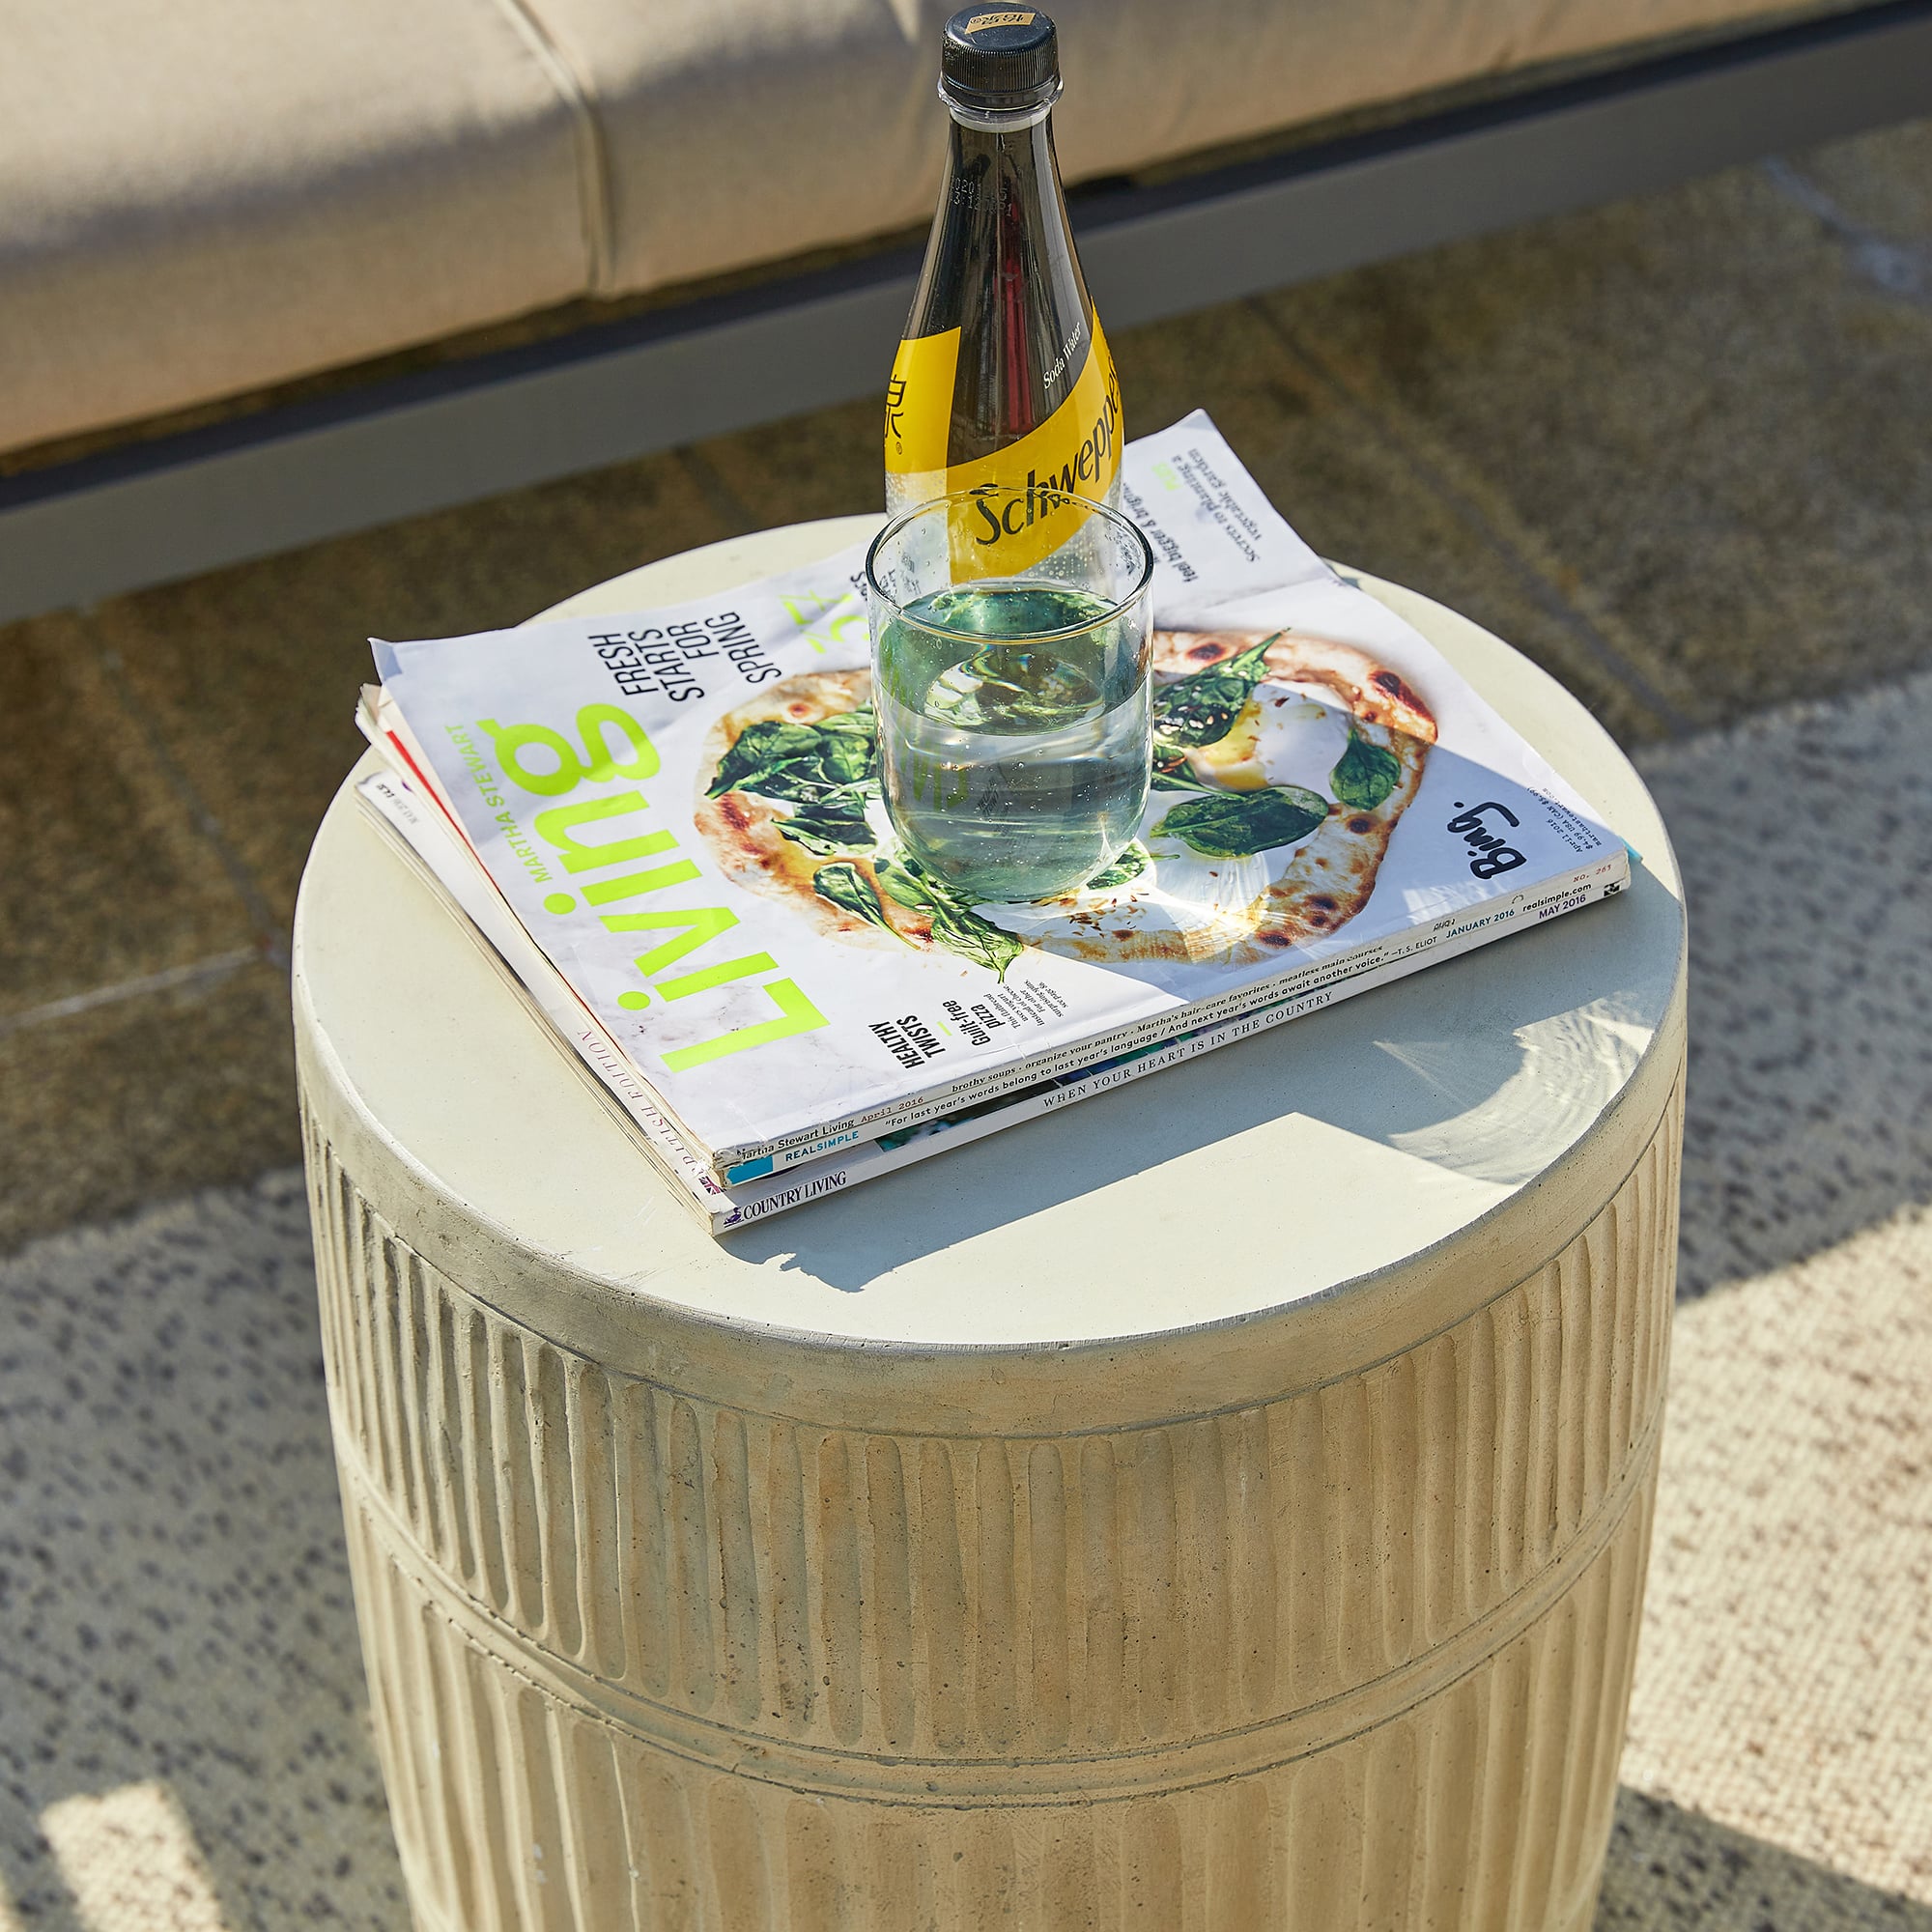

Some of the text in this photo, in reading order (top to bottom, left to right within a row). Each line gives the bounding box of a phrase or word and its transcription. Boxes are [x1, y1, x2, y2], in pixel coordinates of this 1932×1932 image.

[1043, 322, 1080, 389] Soda Water
[1178, 463, 1221, 512] planting
[1188, 448, 1262, 541] vegetable garden
[1213, 511, 1228, 525] to
[1150, 529, 1183, 562] bigger
[1226, 525, 1261, 562] Secrets
[667, 621, 720, 660] FOR
[704, 611, 781, 684] SPRING
[587, 633, 659, 696] FRESH
[628, 629, 705, 702] STARTS
[444, 724, 553, 883] MARTHA STEWART
[1547, 806, 1564, 820] (CAN
[1562, 819, 1576, 832] USA
[1447, 801, 1526, 879] Bing.
[1546, 818, 1583, 852] April 2016
[1574, 832, 1593, 850] $4.99
[476, 703, 830, 1073] Living
[785, 1131, 859, 1161] REALSIMPLE
[910, 1107, 931, 1121] last
[933, 1096, 966, 1114] year's
[968, 1086, 1000, 1100] words
[1003, 1073, 1037, 1091] belong
[1040, 1067, 1052, 1076] to
[1054, 1060, 1075, 1072] last
[1077, 1049, 1109, 1065] year's
[1110, 1034, 1159, 1055] language
[1168, 1019, 1188, 1034] And
[1191, 1012, 1214, 1026] next
[1216, 1002, 1247, 1019] year's
[1249, 991, 1280, 1006] words
[1282, 980, 1311, 996] await
[1313, 965, 1353, 984] another
[1415, 936, 1437, 951] ELIOT
[1446, 917, 1492, 939] JANUARY
[1493, 909, 1516, 923] 2016
[1522, 883, 1592, 913] realsimple.com
[942, 1000, 991, 1046] Guilt-free
[971, 1003, 1007, 1030] pizza
[983, 993, 1021, 1029] This flatbread
[998, 993, 1028, 1021] uses yogurt
[1016, 1001, 1027, 1010] of
[1020, 989, 1046, 1013] For other
[1023, 1006, 1044, 1026] instead
[743, 894, 1586, 1220] COUNTRY LIVING WHEN YOUR HEART IS IN THE COUNTRY MAY 2016
[778, 1129, 818, 1149] Stewart
[822, 1119, 855, 1136] Living
[861, 1108, 893, 1123] April
[898, 1096, 924, 1110] 2016
[952, 1075, 985, 1094] brothy
[988, 1066, 1016, 1083] soups
[1025, 1052, 1067, 1070] organize
[1069, 1043, 1094, 1058] your
[1137, 1013, 1179, 1034] Martha's
[1180, 998, 1227, 1020] hair-care
[1228, 982, 1270, 1004] favorites
[1279, 968, 1320, 986] meatless
[1321, 958, 1346, 972] main
[1347, 945, 1383, 962] courses
[867, 1020, 926, 1069] HEALTHY
[896, 1014, 947, 1059] TWISTS
